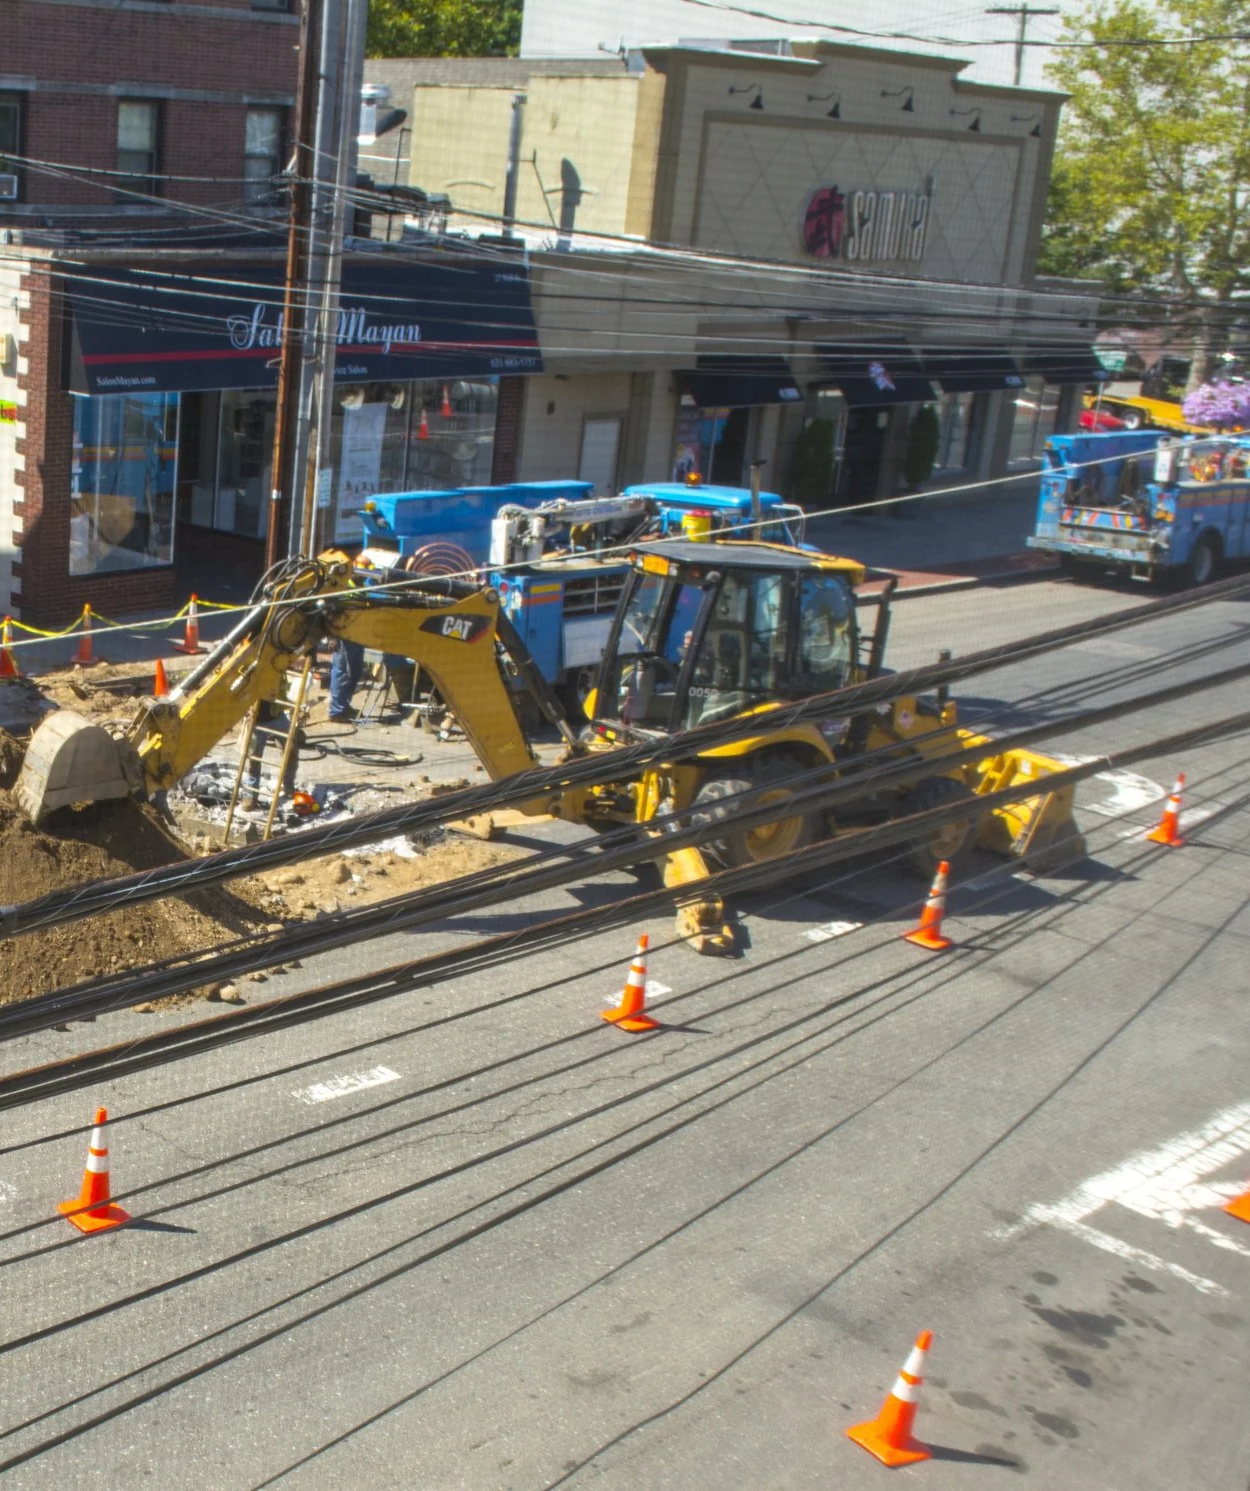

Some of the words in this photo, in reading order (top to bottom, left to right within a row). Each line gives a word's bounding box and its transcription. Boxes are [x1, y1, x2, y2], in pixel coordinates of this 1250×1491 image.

[226, 304, 285, 350] Sal
[337, 307, 422, 355] Mayan
[442, 616, 473, 640] CAT
